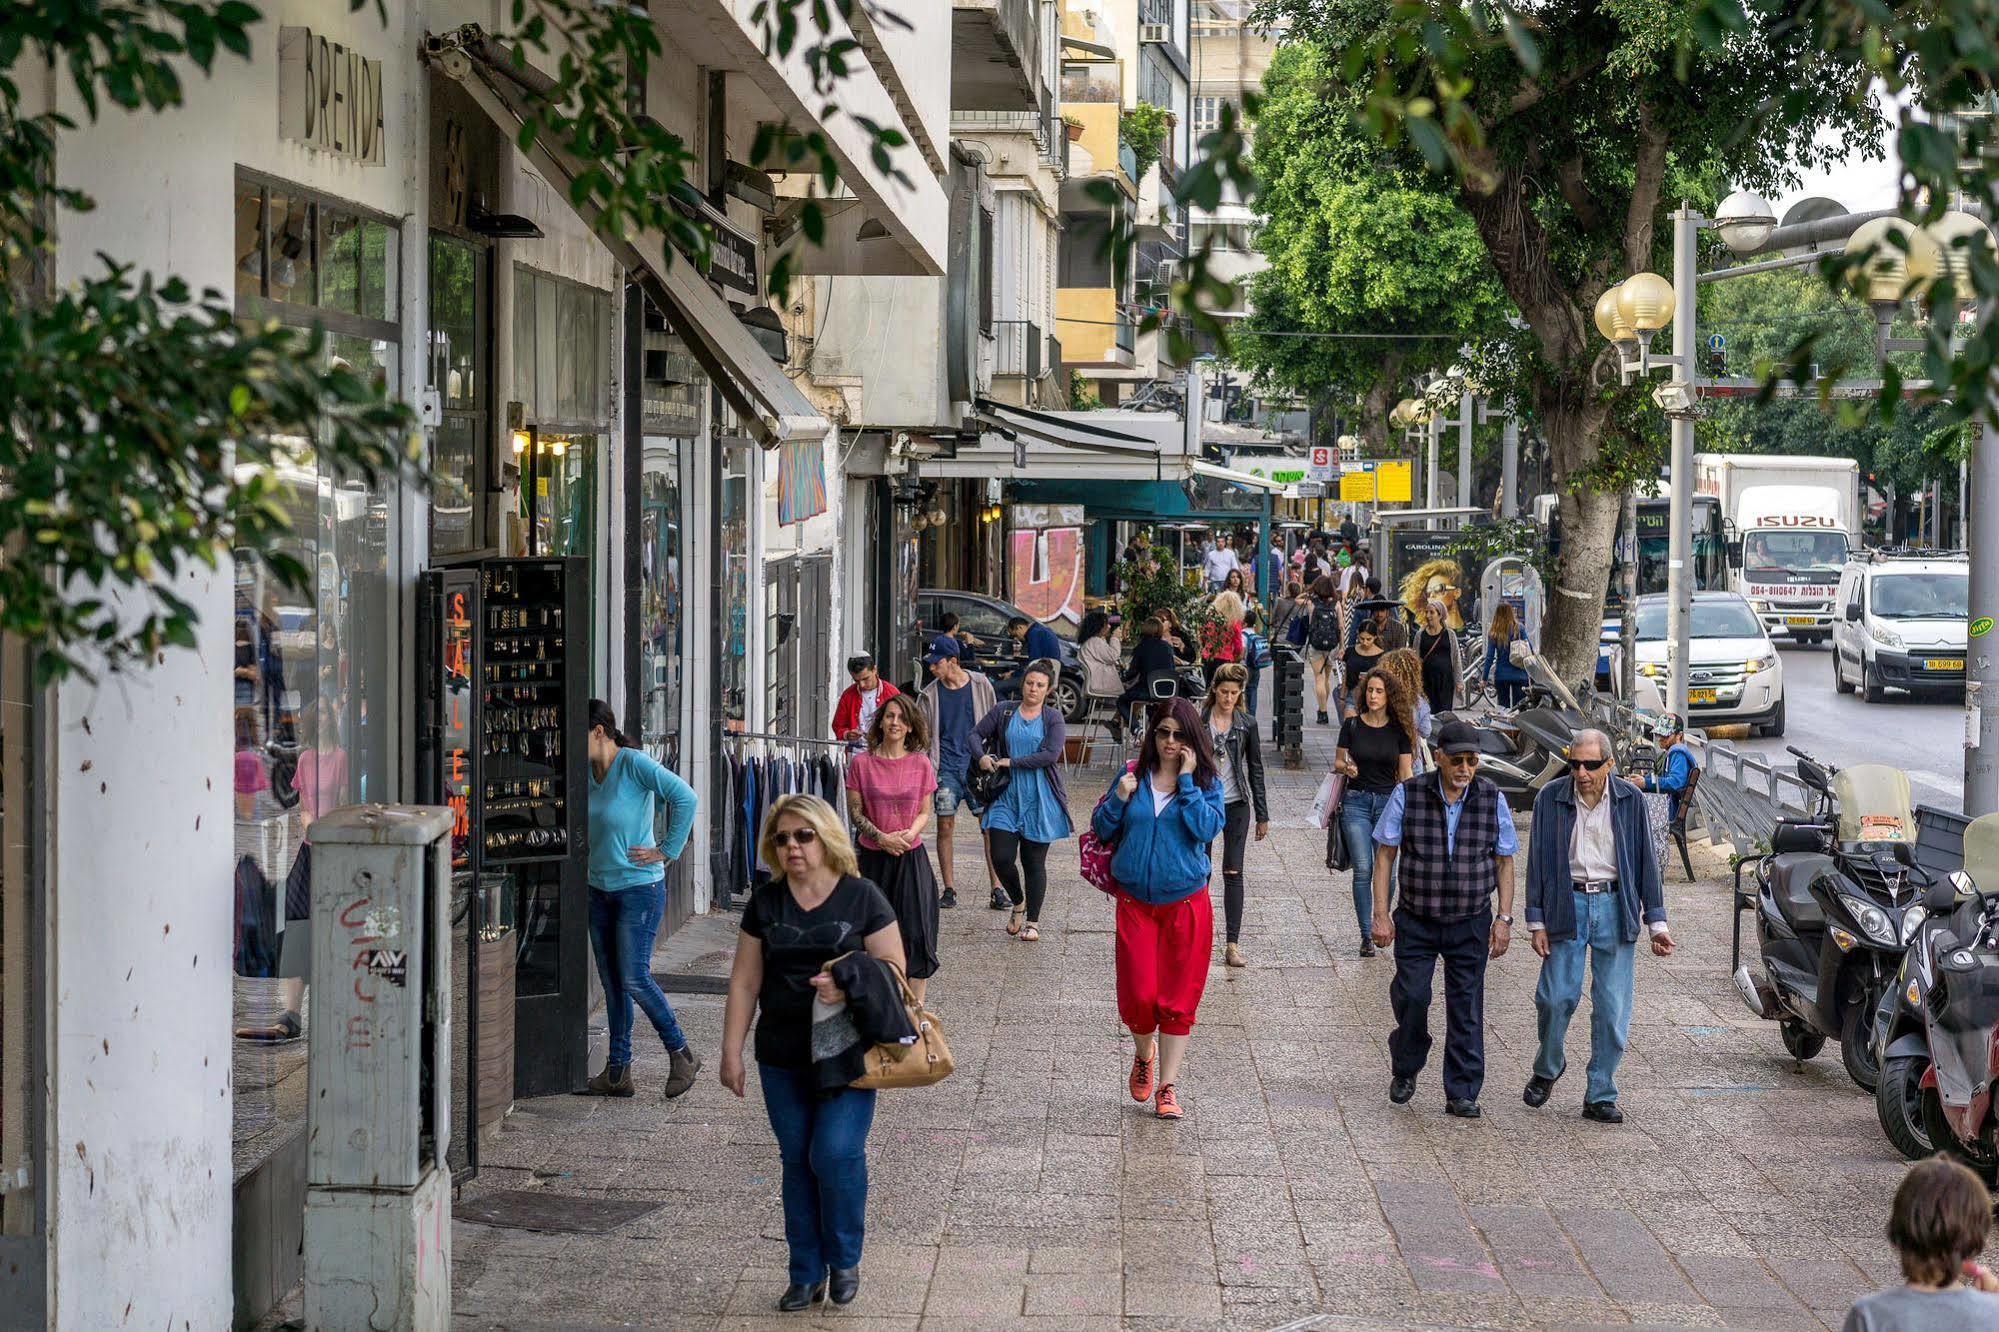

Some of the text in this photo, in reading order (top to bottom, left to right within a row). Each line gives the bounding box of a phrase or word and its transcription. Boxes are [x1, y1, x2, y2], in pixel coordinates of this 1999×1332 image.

[290, 26, 386, 168] BRENDA
[1756, 515, 1835, 528] ISUZU
[1801, 584, 1824, 597] הובלות
